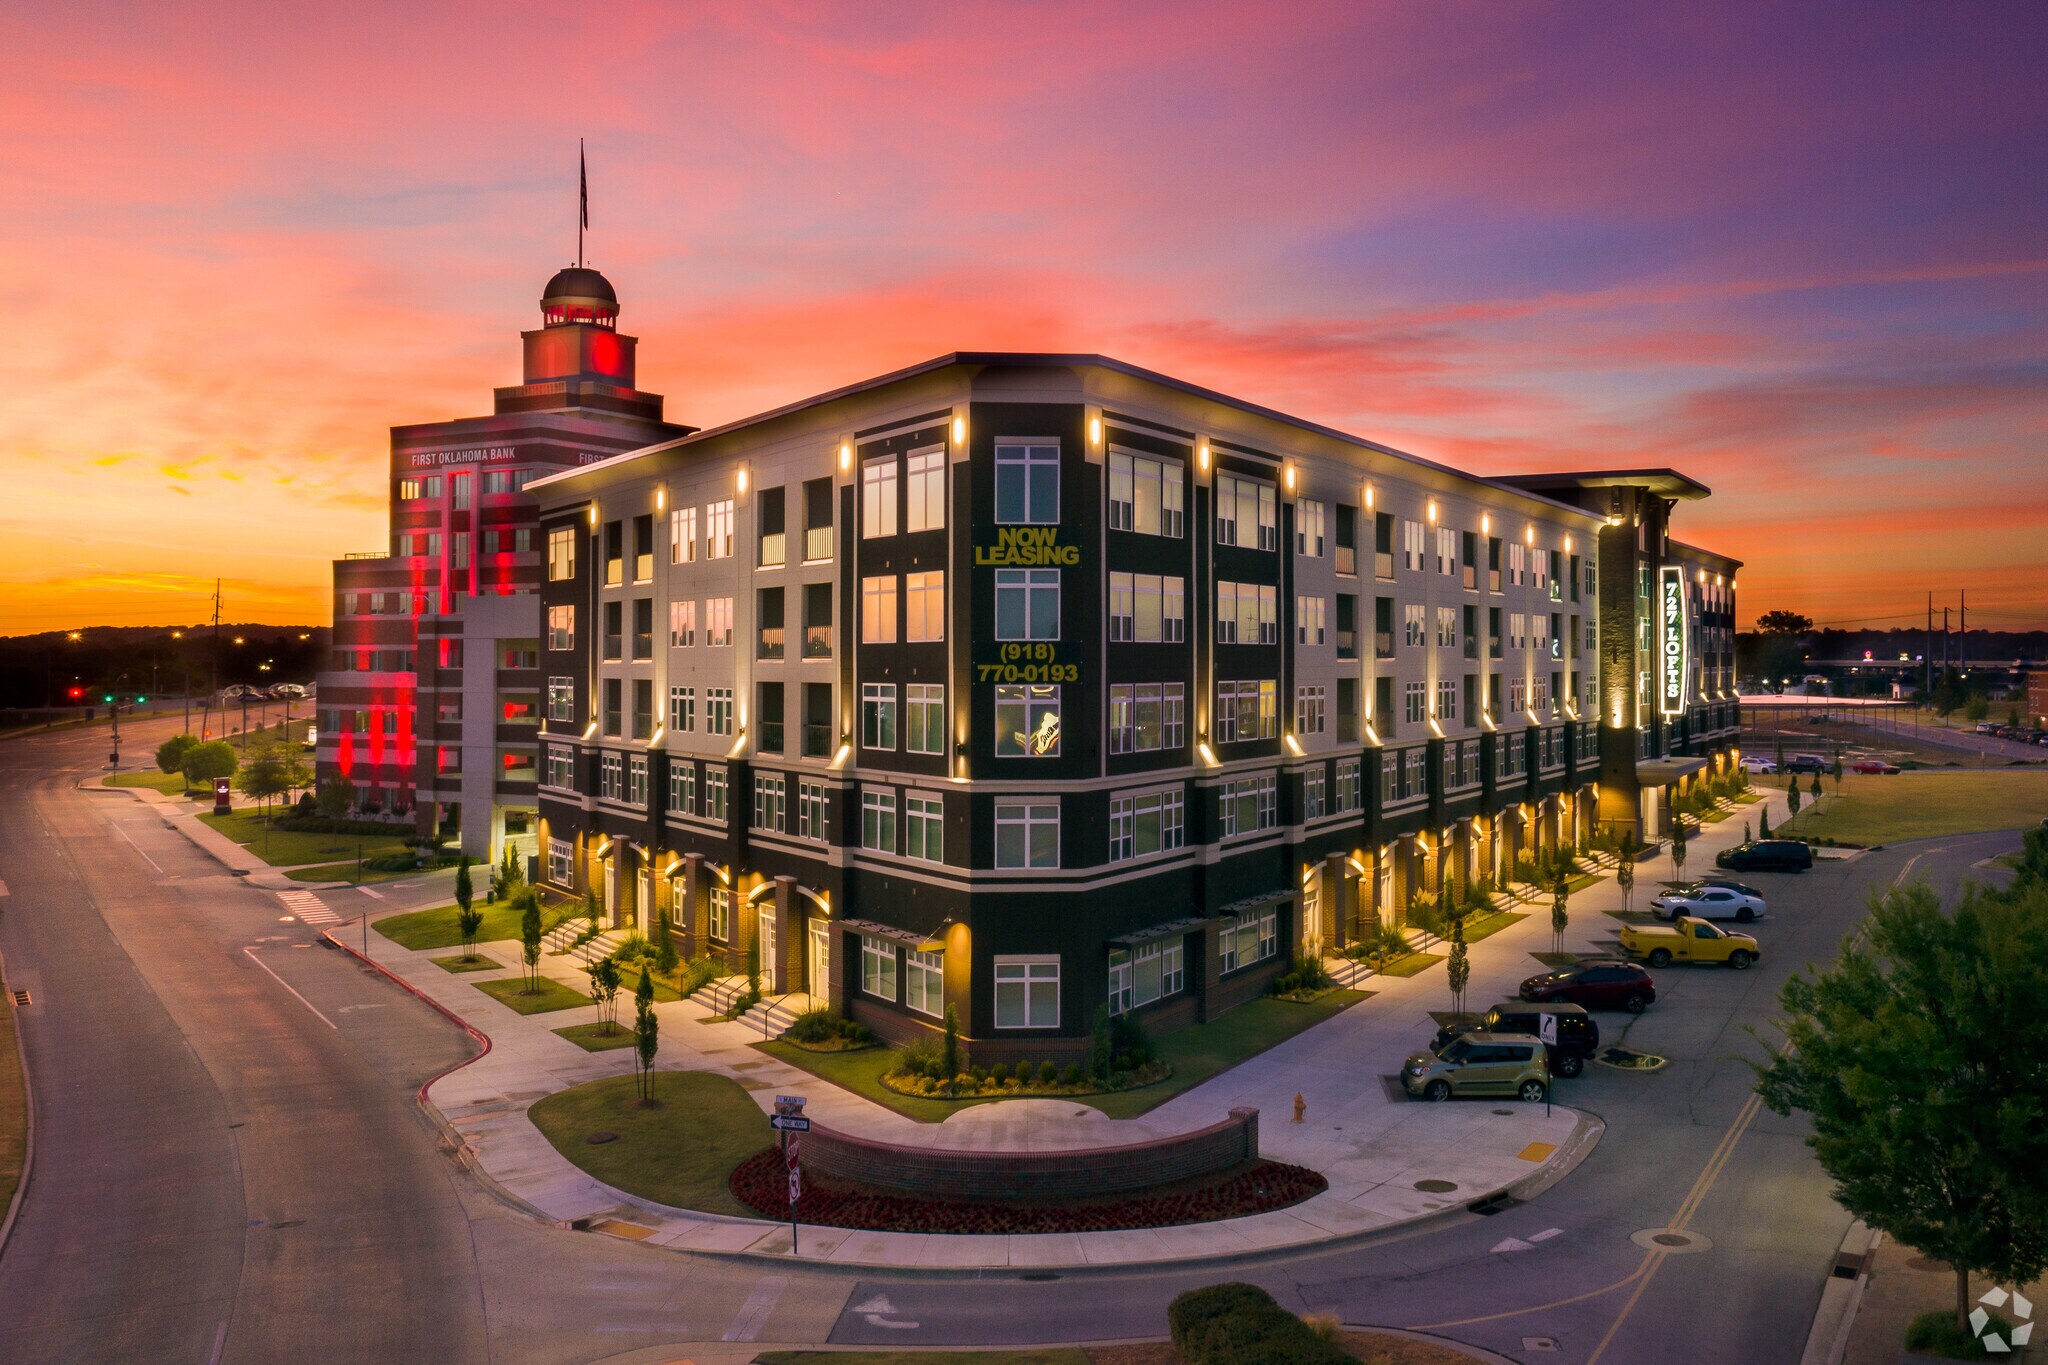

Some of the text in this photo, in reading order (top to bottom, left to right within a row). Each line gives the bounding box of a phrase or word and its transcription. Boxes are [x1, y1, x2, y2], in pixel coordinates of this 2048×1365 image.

[412, 447, 516, 466] FIRST OKLAHOMA BANK
[998, 528, 1057, 547] NOW
[975, 546, 1080, 565] LEASING
[1665, 583, 1680, 698] 727 LOFTS
[1000, 643, 1056, 663] (918)
[977, 664, 1078, 682] 770-0193
[783, 1096, 798, 1104] MAIN
[781, 1119, 806, 1128] ONE WAY
